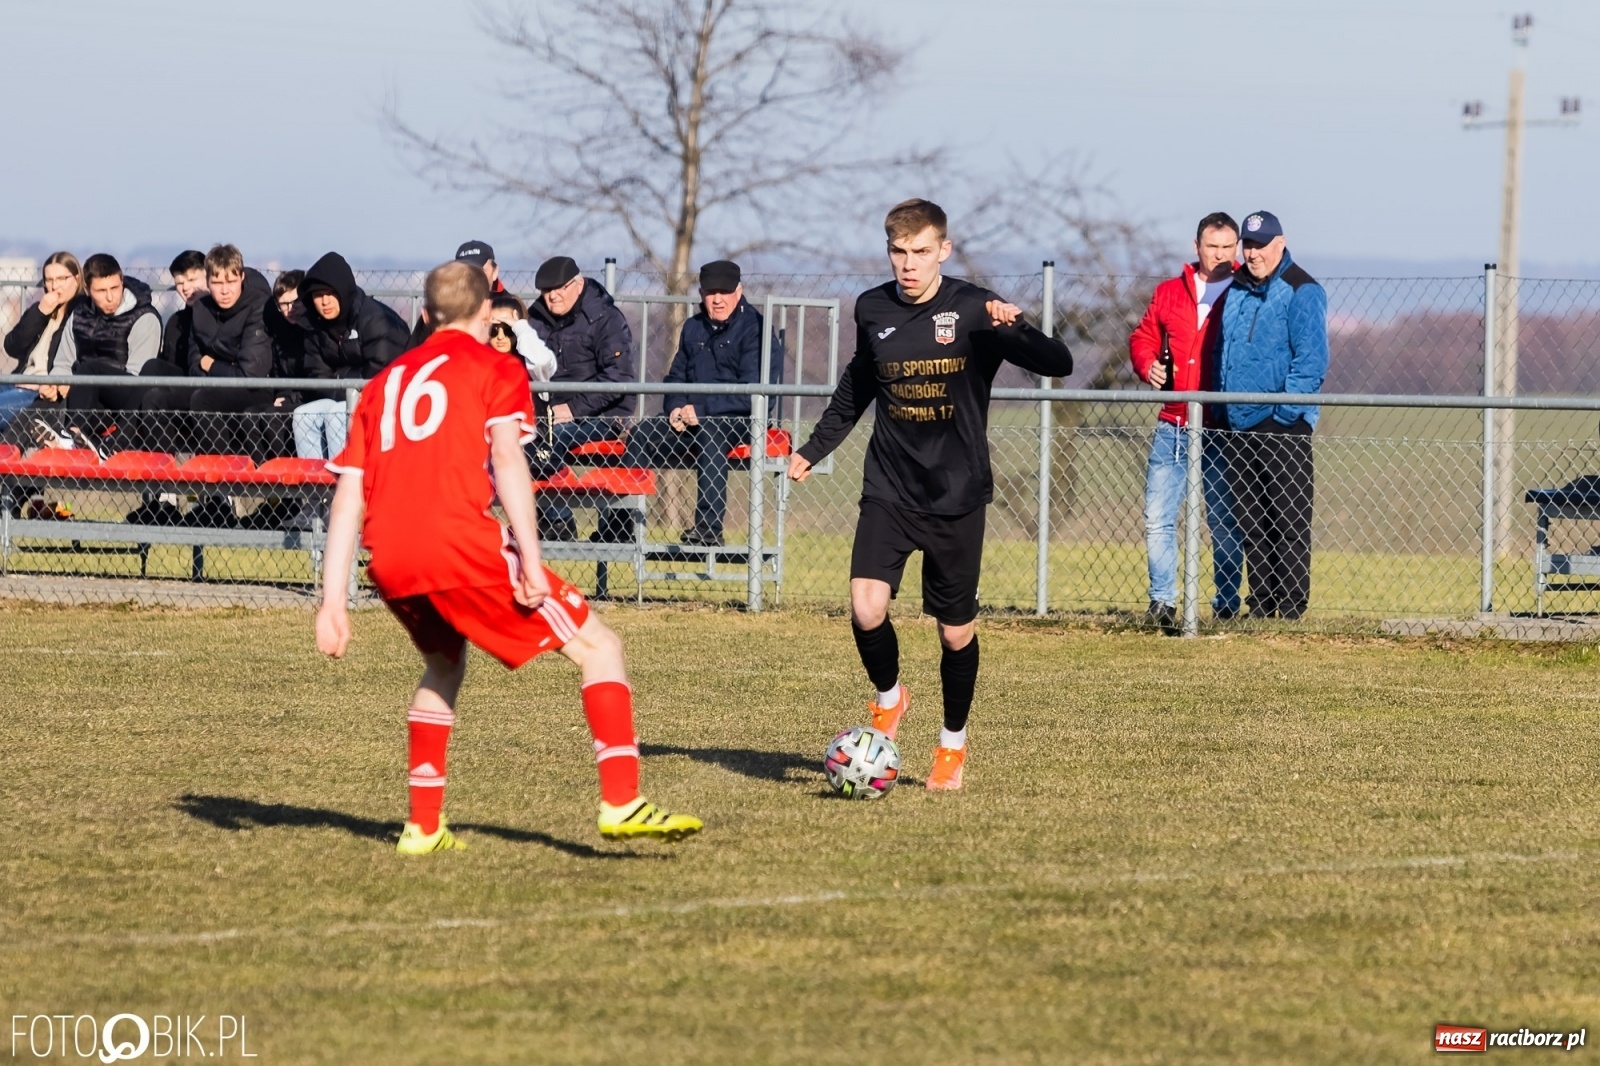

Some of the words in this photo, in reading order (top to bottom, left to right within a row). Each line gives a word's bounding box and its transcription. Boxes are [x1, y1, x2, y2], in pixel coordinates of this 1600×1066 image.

[938, 328, 953, 338] KS
[902, 356, 967, 377] SPORTOWY
[890, 381, 947, 399] RACIBÓRZ
[380, 353, 450, 452] 16
[888, 404, 937, 422] CHOPINA
[939, 404, 954, 420] 17
